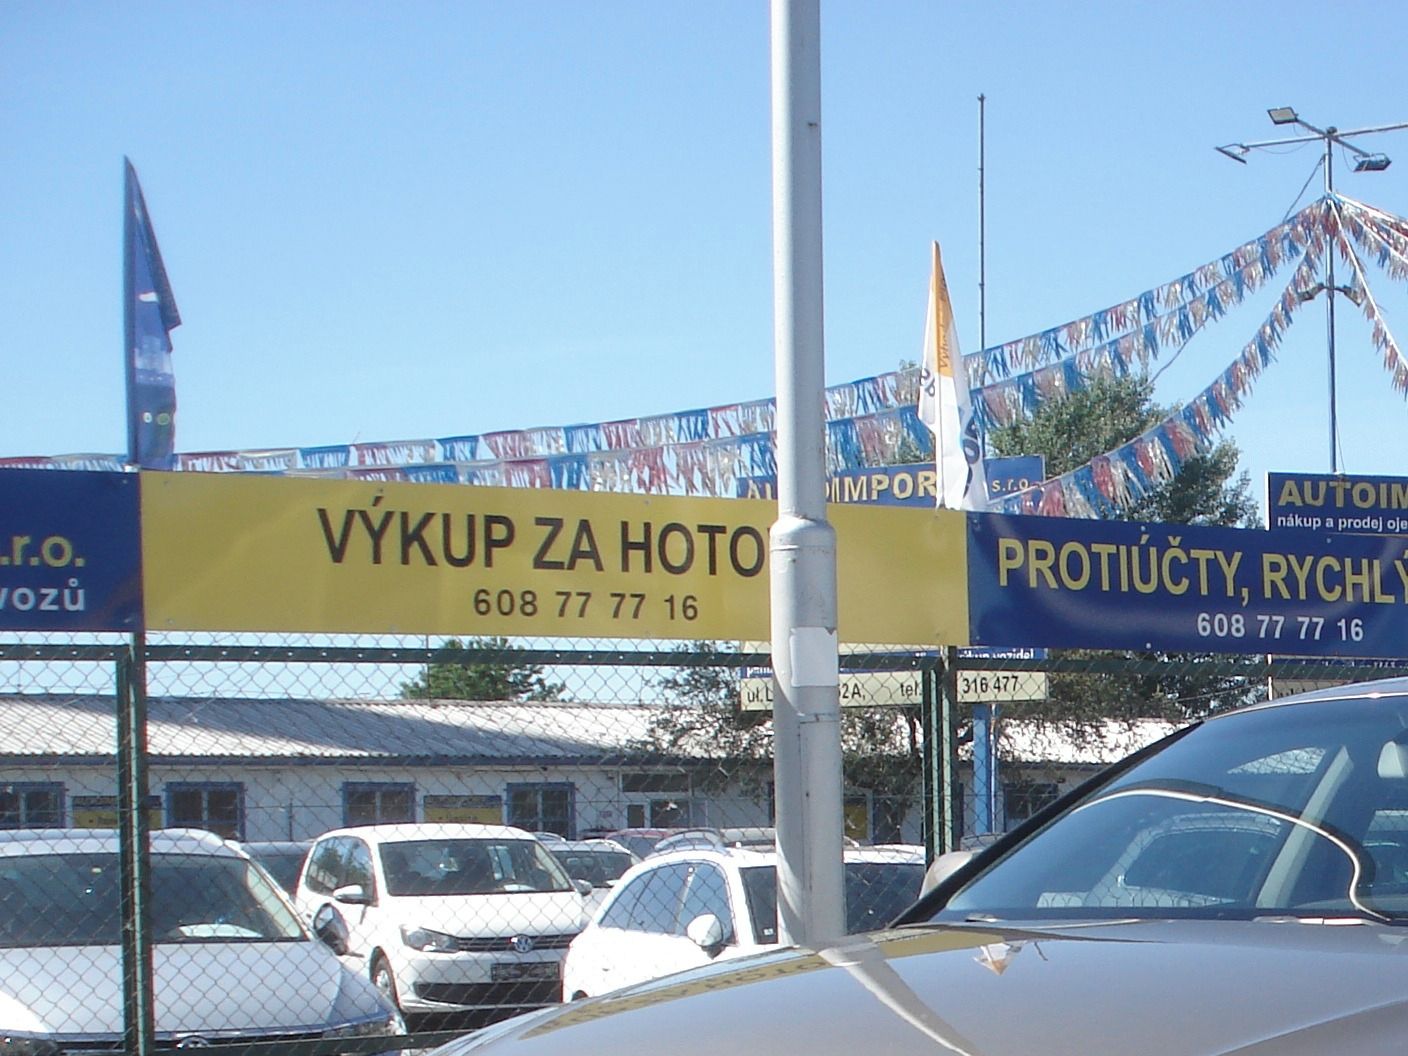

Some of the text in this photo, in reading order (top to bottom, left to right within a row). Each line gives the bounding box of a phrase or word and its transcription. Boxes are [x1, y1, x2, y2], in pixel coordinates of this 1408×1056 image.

[316, 495, 770, 578] VÝKUP ZA HOTO
[1277, 513, 1322, 531] nákup
[1325, 517, 1334, 528] a
[1338, 516, 1383, 533] prodej
[998, 533, 1250, 605] PROTIÚČTY,
[473, 588, 699, 622] 608 77 77 16
[1195, 612, 1364, 642] 608 77 77 16
[900, 680, 923, 697] tel.
[962, 676, 989, 694] 316
[993, 675, 1019, 693] 477
